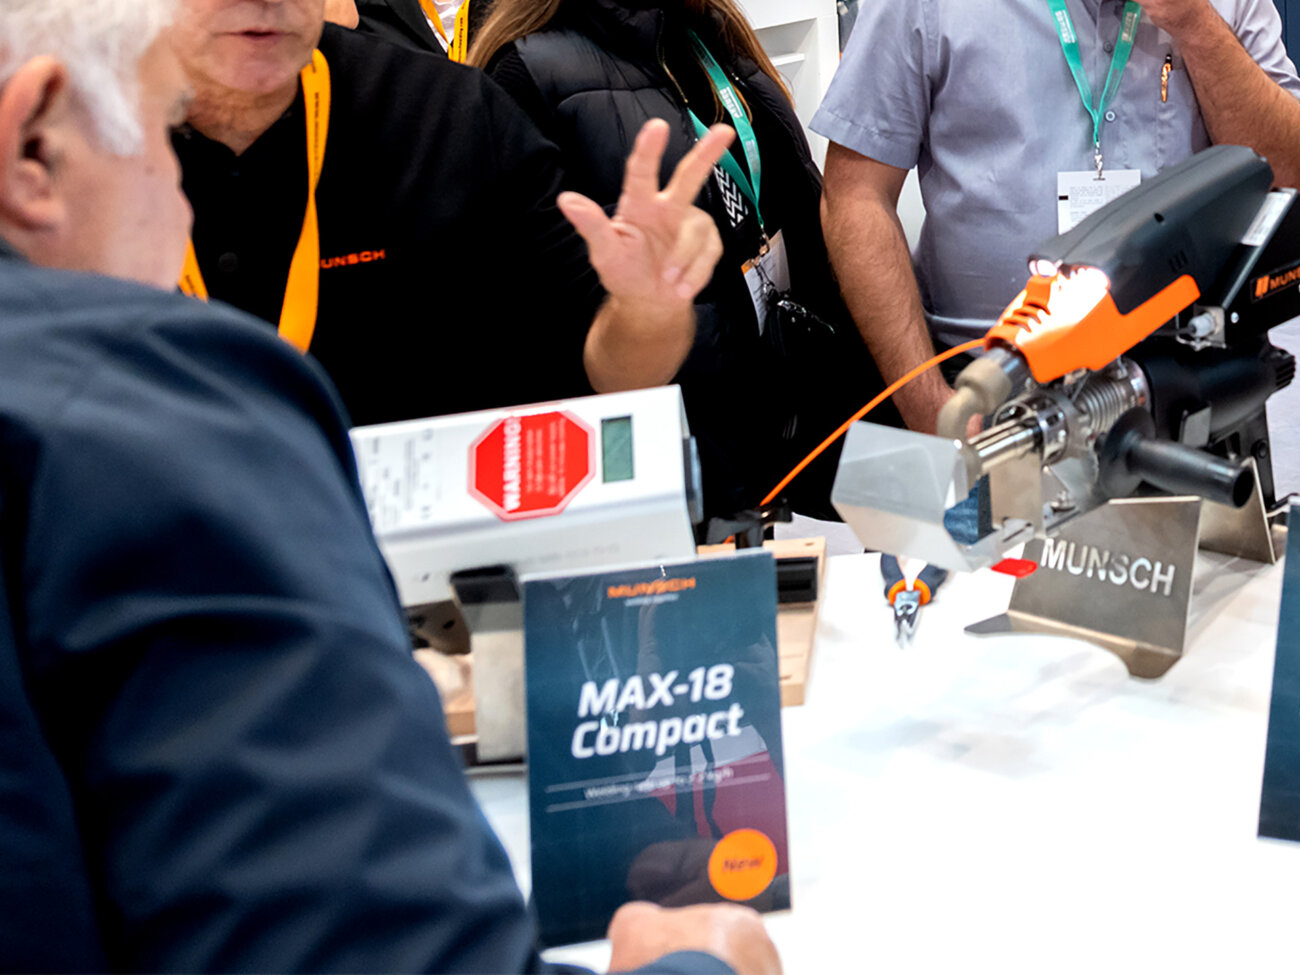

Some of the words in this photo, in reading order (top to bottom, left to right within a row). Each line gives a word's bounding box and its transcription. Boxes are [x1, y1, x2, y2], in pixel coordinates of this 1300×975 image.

[320, 249, 385, 269] UNSCH
[607, 577, 696, 599] MUNSCH
[1040, 537, 1175, 596] MUNSCH
[578, 664, 734, 718] MAX-18
[572, 703, 744, 758] Compact
